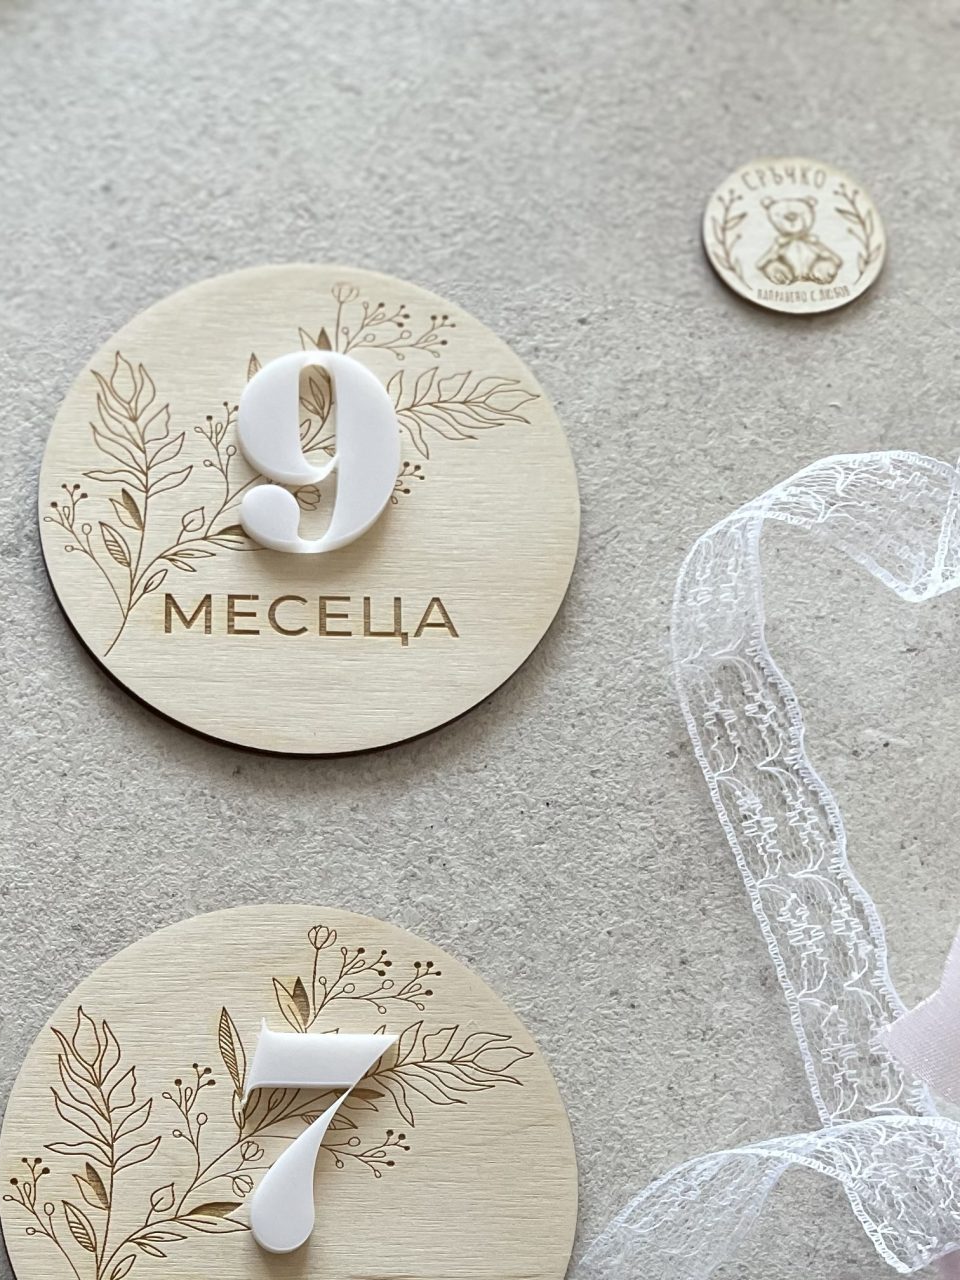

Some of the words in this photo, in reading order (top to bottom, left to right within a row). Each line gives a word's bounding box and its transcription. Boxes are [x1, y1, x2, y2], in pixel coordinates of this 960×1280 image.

[741, 166, 827, 191] СРЪЧКО
[237, 350, 401, 553] 9
[163, 593, 460, 646] МЕСЕЦА
[241, 1017, 399, 1254] 7
